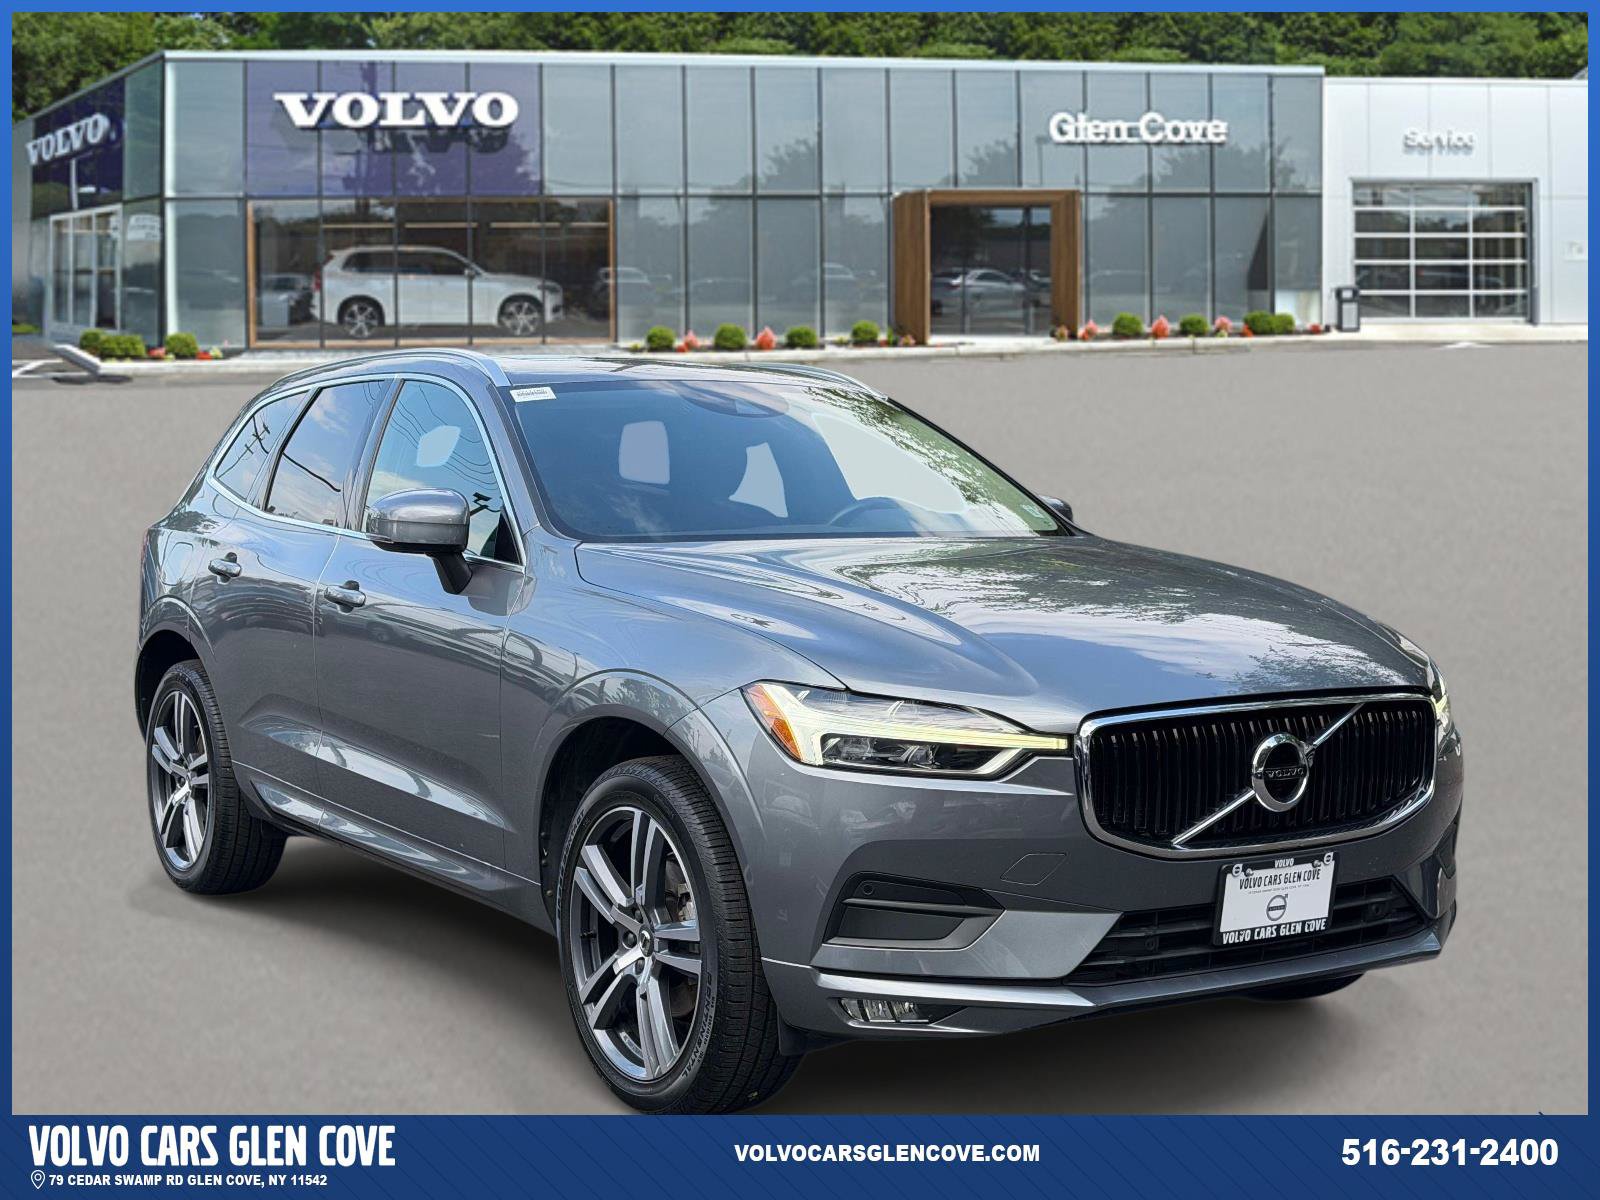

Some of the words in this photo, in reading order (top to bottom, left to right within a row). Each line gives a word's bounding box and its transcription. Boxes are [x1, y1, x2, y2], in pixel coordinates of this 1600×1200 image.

[272, 91, 519, 128] VOLVO
[25, 113, 111, 165] VOLVO
[1049, 112, 1131, 143] Glen
[1138, 112, 1229, 143] Cove
[1402, 127, 1476, 155] Service
[1265, 767, 1304, 778] VOLVO
[1274, 858, 1295, 869] VOLVO
[1239, 876, 1263, 890] VOLVO
[1263, 873, 1283, 888] CARS
[1283, 871, 1302, 884] GLEN
[1303, 868, 1322, 882] COVE
[1222, 930, 1251, 944] VOLVO
[1254, 926, 1277, 939] CARS
[1280, 921, 1302, 936] GLEN
[1305, 919, 1326, 932] COVE
[681, 971, 712, 1078] CONTINENTAL
